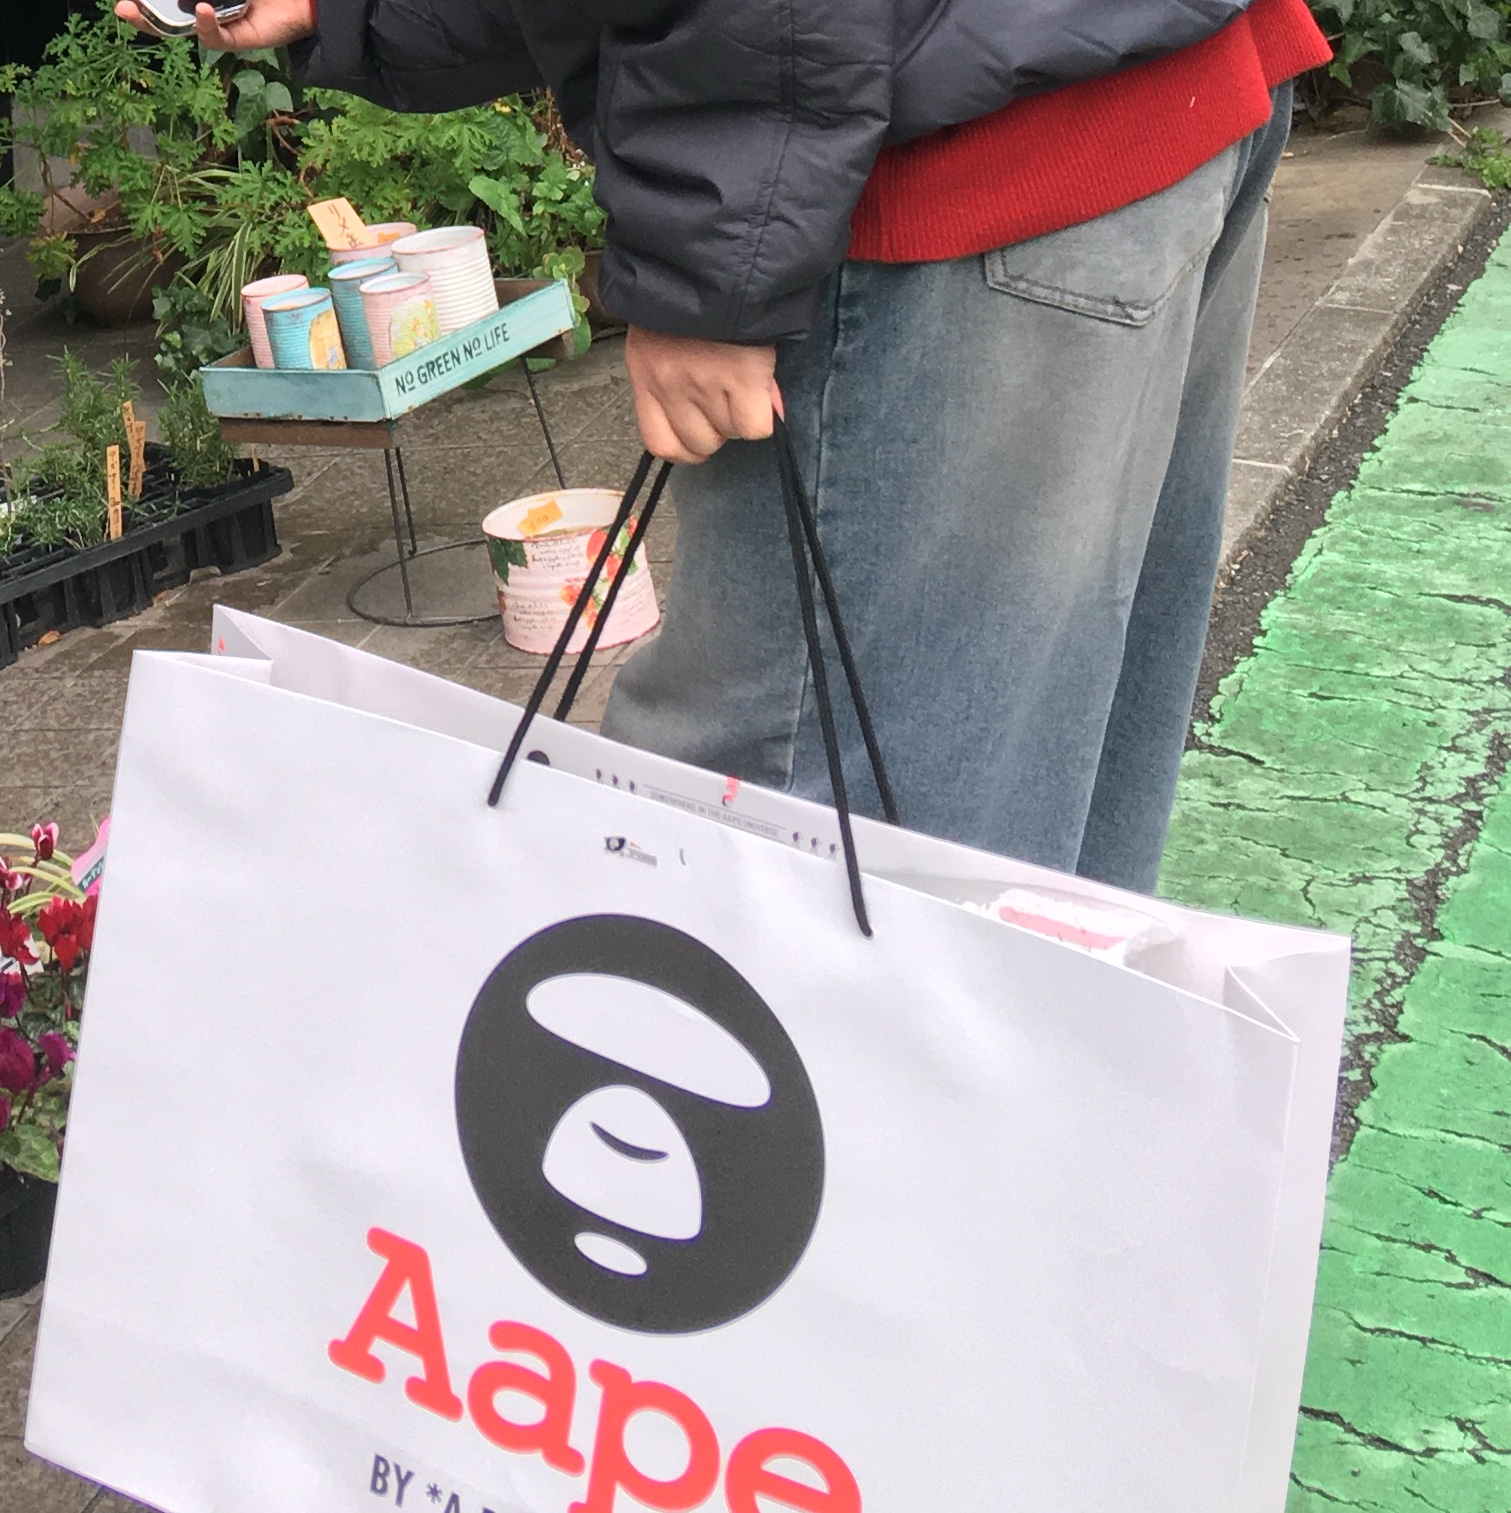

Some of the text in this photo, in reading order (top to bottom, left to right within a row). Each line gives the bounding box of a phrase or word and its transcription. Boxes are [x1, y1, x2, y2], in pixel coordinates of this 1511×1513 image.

[417, 347, 462, 385] GREEN
[484, 322, 510, 351] LIFE
[327, 1226, 863, 1513] Aape
[369, 1453, 417, 1508] BY
